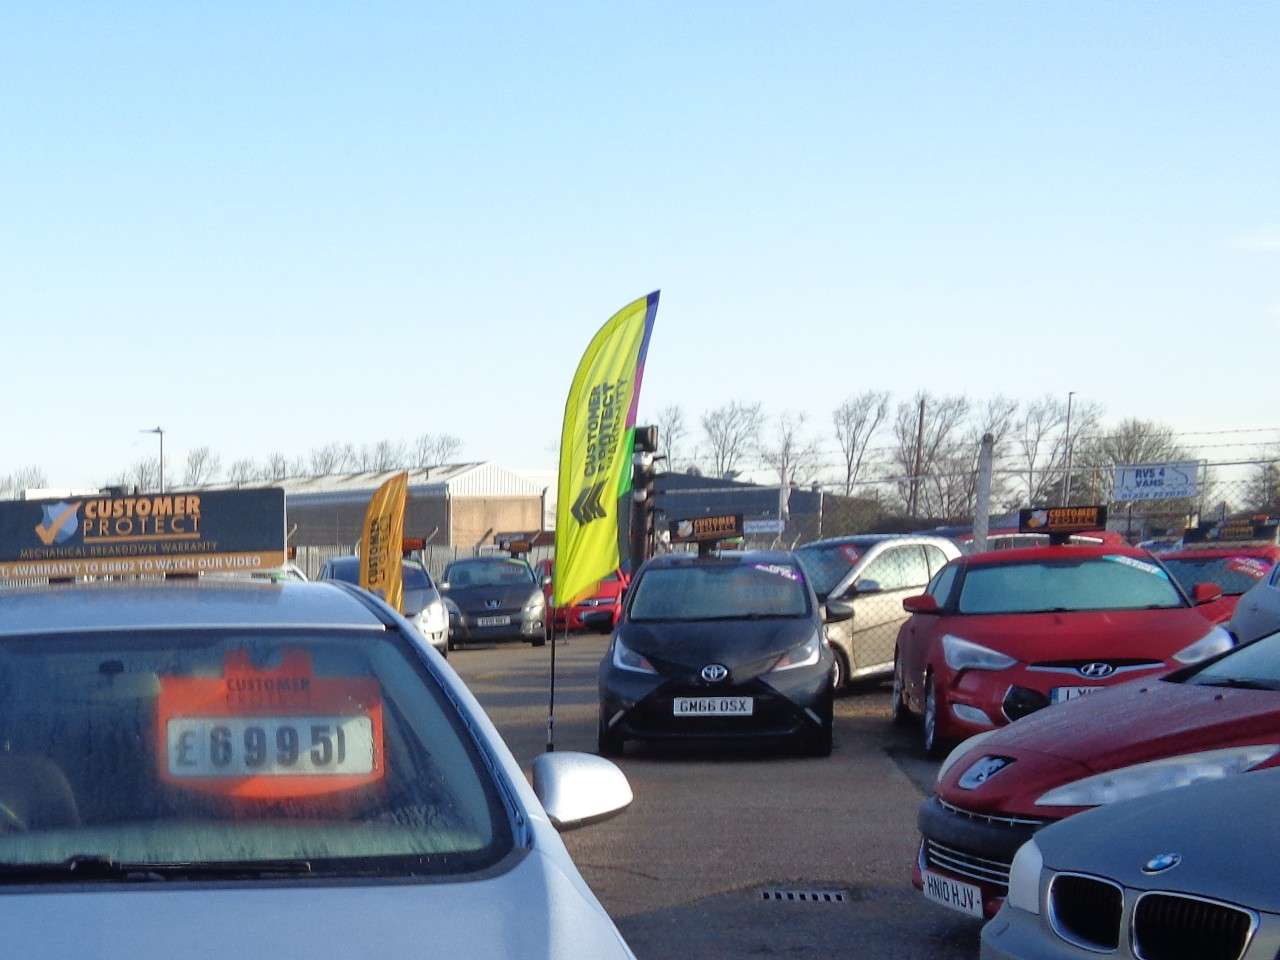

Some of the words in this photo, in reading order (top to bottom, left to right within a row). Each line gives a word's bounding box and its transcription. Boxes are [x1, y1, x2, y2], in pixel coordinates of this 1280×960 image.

[584, 384, 601, 477] CUSTOMER
[85, 495, 201, 519] CUSTOMER
[83, 514, 200, 537] PROTECT
[90, 543, 157, 556] BREAKDOWN
[161, 541, 218, 553] WARRANTY
[13, 564, 82, 577] 4WARRANTY
[85, 563, 98, 574] TO
[139, 560, 153, 571] TO
[155, 558, 195, 571] WATCH
[198, 557, 223, 569] OUR
[225, 556, 261, 567] VIDEO
[680, 700, 716, 712] GM66
[952, 884, 974, 909] HJV
